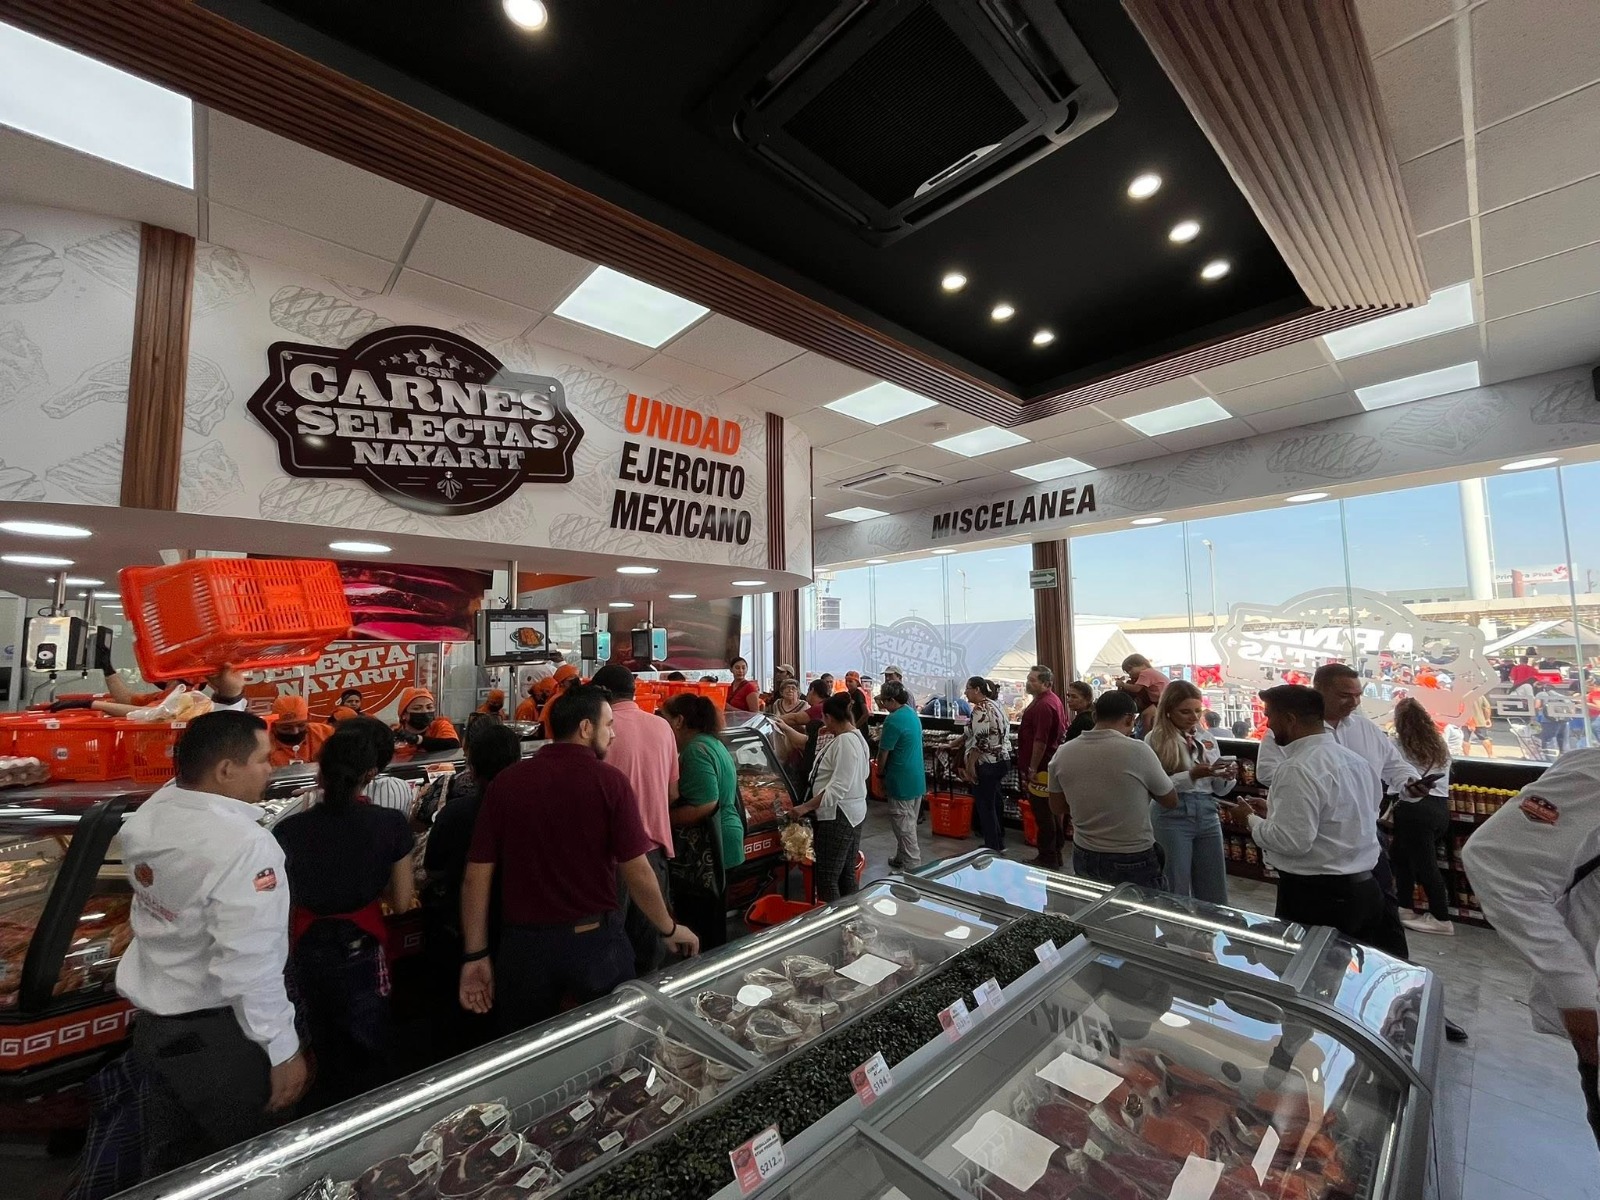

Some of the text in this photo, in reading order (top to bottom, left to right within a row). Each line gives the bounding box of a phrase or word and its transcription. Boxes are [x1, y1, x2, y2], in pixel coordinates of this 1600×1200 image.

[289, 363, 556, 422] CARNES
[415, 364, 455, 380] CSN
[295, 404, 559, 449] SELECTAS
[624, 393, 742, 456] UNIDAD
[351, 440, 526, 470] NAYARIT
[618, 440, 746, 501] EJERCITO
[609, 488, 752, 546] MEXICANO
[931, 483, 1097, 540] MISCELANEA
[276, 664, 409, 697] NAYARIT
